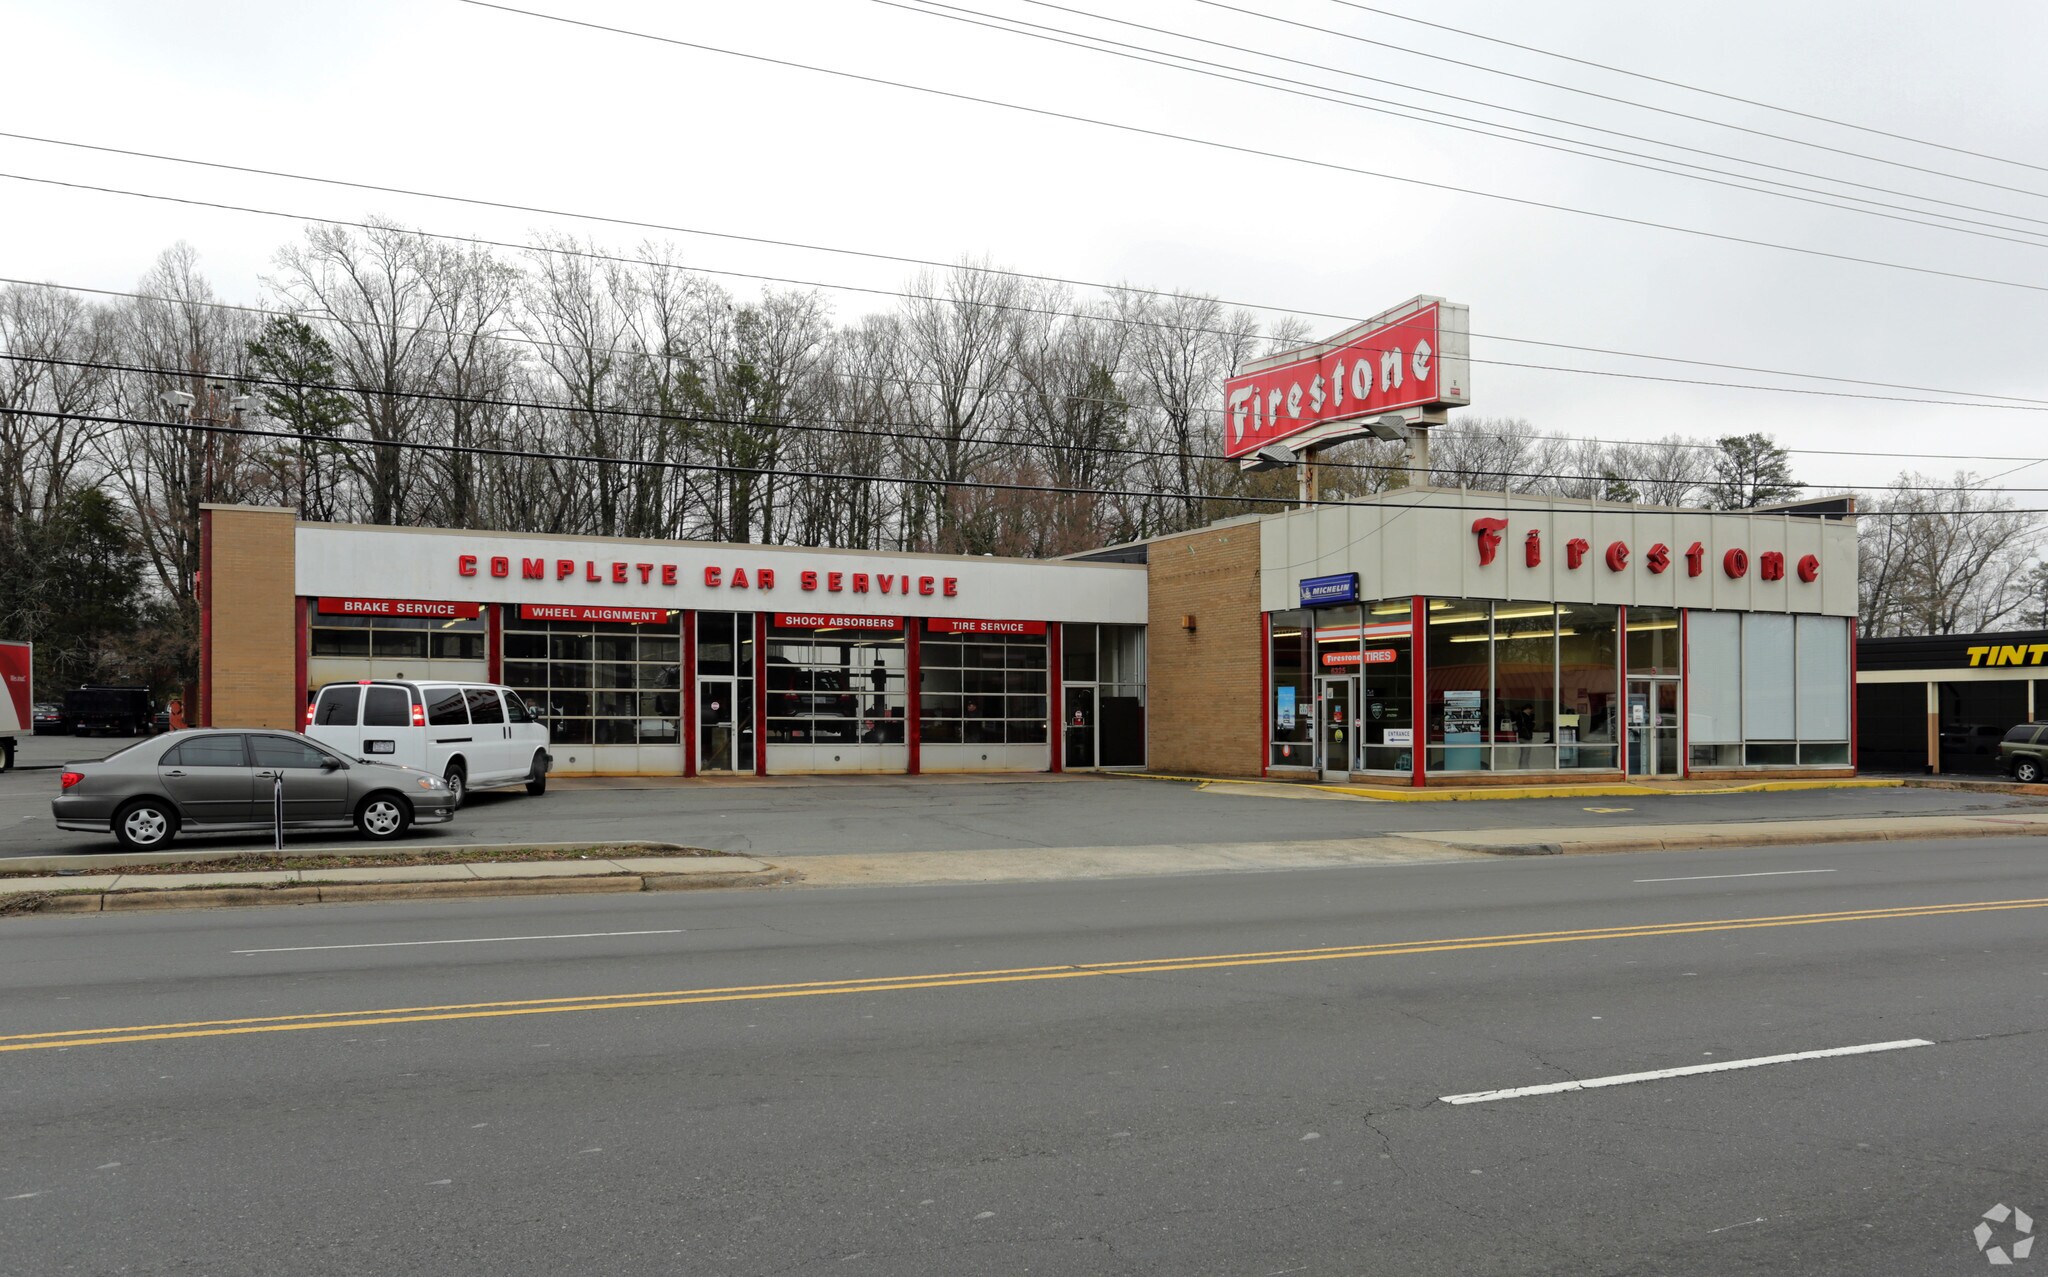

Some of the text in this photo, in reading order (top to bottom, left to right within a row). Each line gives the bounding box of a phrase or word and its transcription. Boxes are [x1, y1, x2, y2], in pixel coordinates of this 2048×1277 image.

[1228, 338, 1432, 445] Firestone
[1472, 517, 1820, 584] Firestone
[458, 554, 958, 597] COMPLETE CAR SERVICE
[1312, 583, 1350, 595] MICHELIN
[344, 601, 455, 615] BRAKE SERVICE
[532, 607, 658, 621] WHEEL ALIGNMENT
[785, 616, 895, 628] SHOCK ABSORBERS
[952, 621, 1025, 632] TIRE SERVICE
[1365, 651, 1391, 661] TIRES
[1966, 644, 2048, 667] TINT
